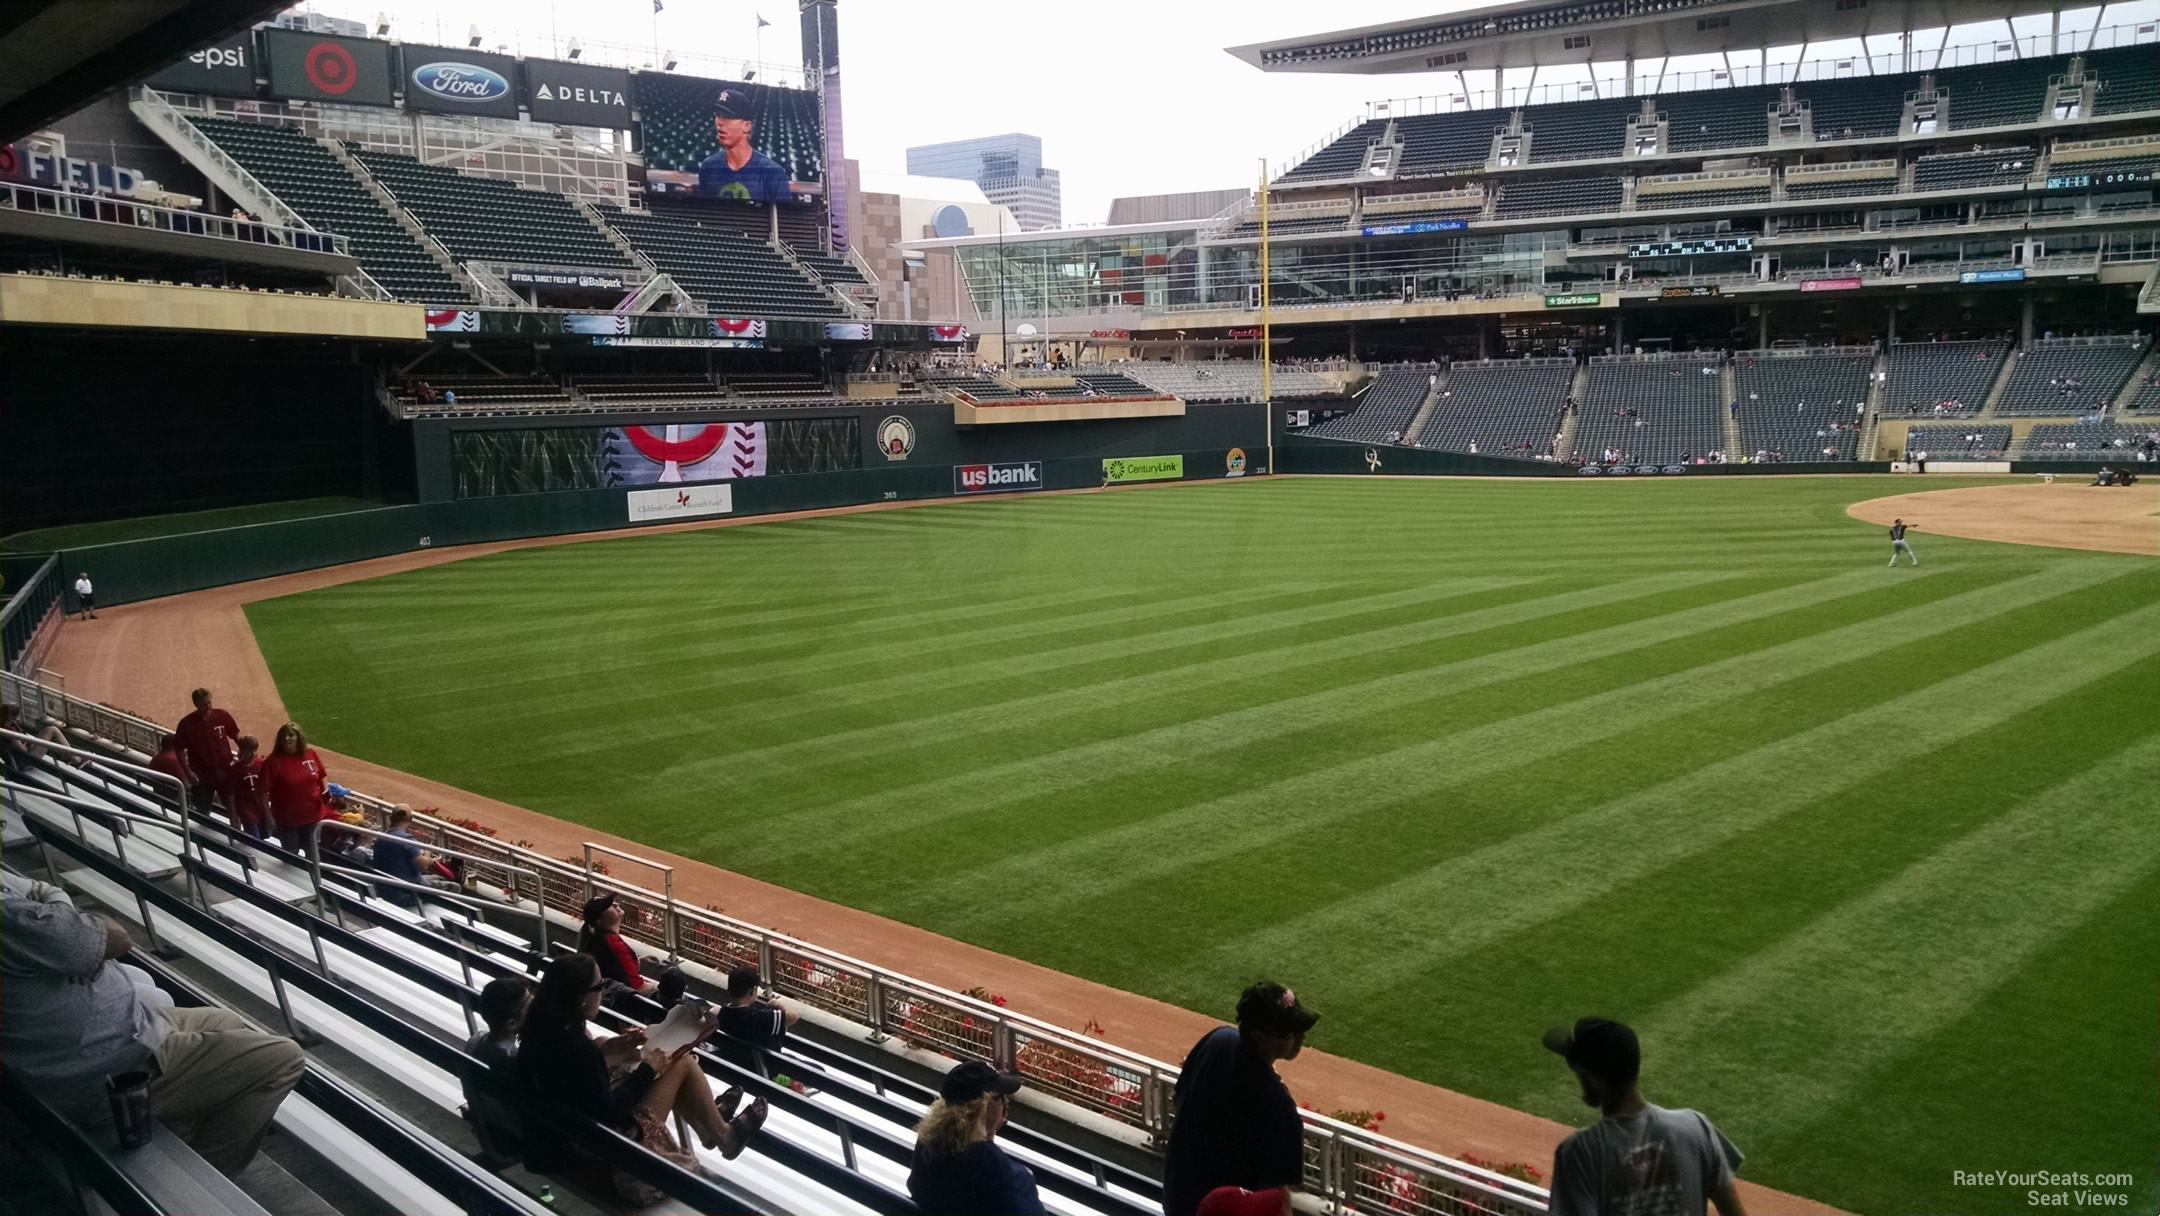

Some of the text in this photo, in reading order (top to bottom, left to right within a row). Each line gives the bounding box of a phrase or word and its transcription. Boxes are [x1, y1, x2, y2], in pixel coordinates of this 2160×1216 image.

[189, 46, 244, 69] epsi
[433, 66, 490, 97] Ford
[559, 86, 625, 106] DELTA
[29, 151, 137, 197] FIELD
[511, 274, 534, 282] OFFICIAL
[534, 275, 552, 283] TARGET
[553, 276, 567, 284] FIELD
[589, 277, 622, 288] Ballpark
[1556, 296, 1598, 305] StarTribune
[642, 338, 677, 346] TREASURE
[680, 338, 705, 346] ISLAND
[1127, 463, 1177, 474] CenturyLink
[884, 491, 897, 499] 365
